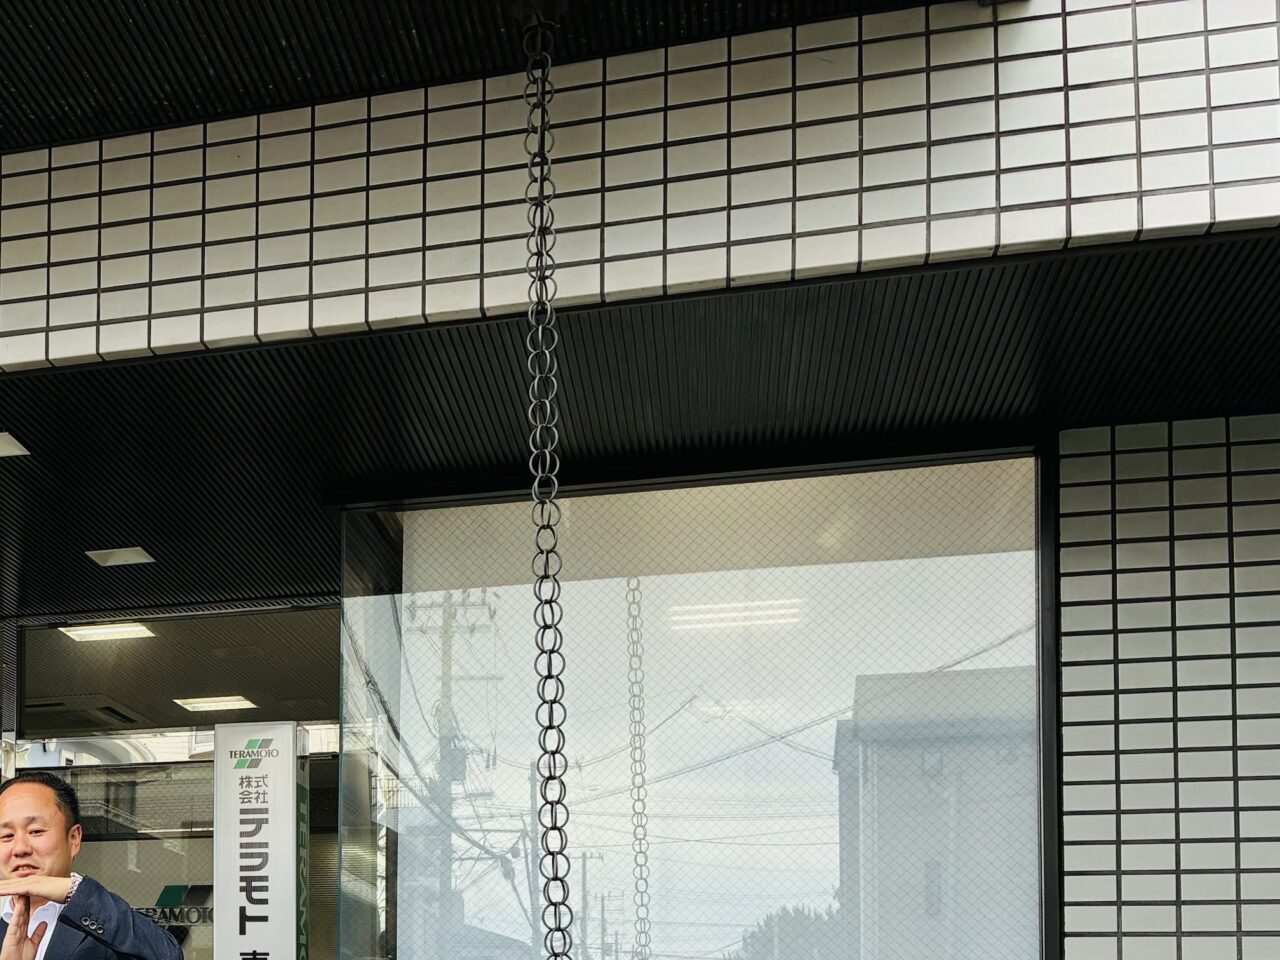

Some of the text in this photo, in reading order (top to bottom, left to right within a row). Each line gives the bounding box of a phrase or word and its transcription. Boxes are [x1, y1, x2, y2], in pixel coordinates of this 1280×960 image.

[228, 748, 280, 759] TERAMOTO
[238, 774, 269, 789] 株式
[238, 790, 269, 804] 会社
[239, 807, 269, 936] テラモト
